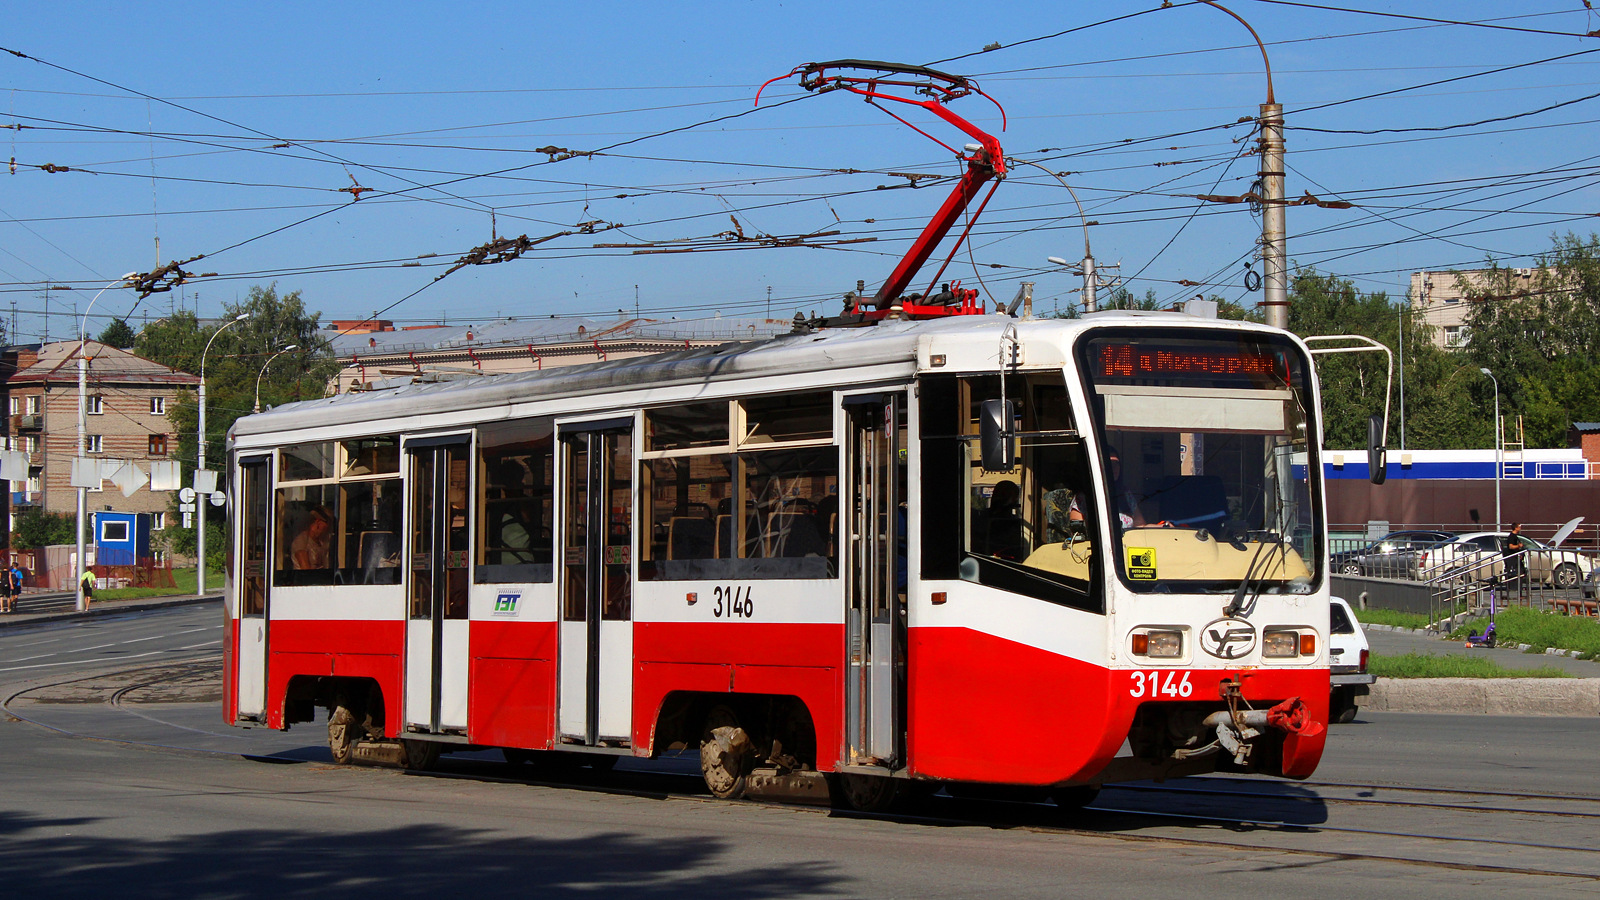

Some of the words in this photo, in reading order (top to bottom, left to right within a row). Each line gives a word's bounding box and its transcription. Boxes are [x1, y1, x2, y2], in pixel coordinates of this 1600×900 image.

[1102, 344, 1133, 376] 14
[713, 586, 753, 618] 3146
[1129, 671, 1193, 697] 3146
